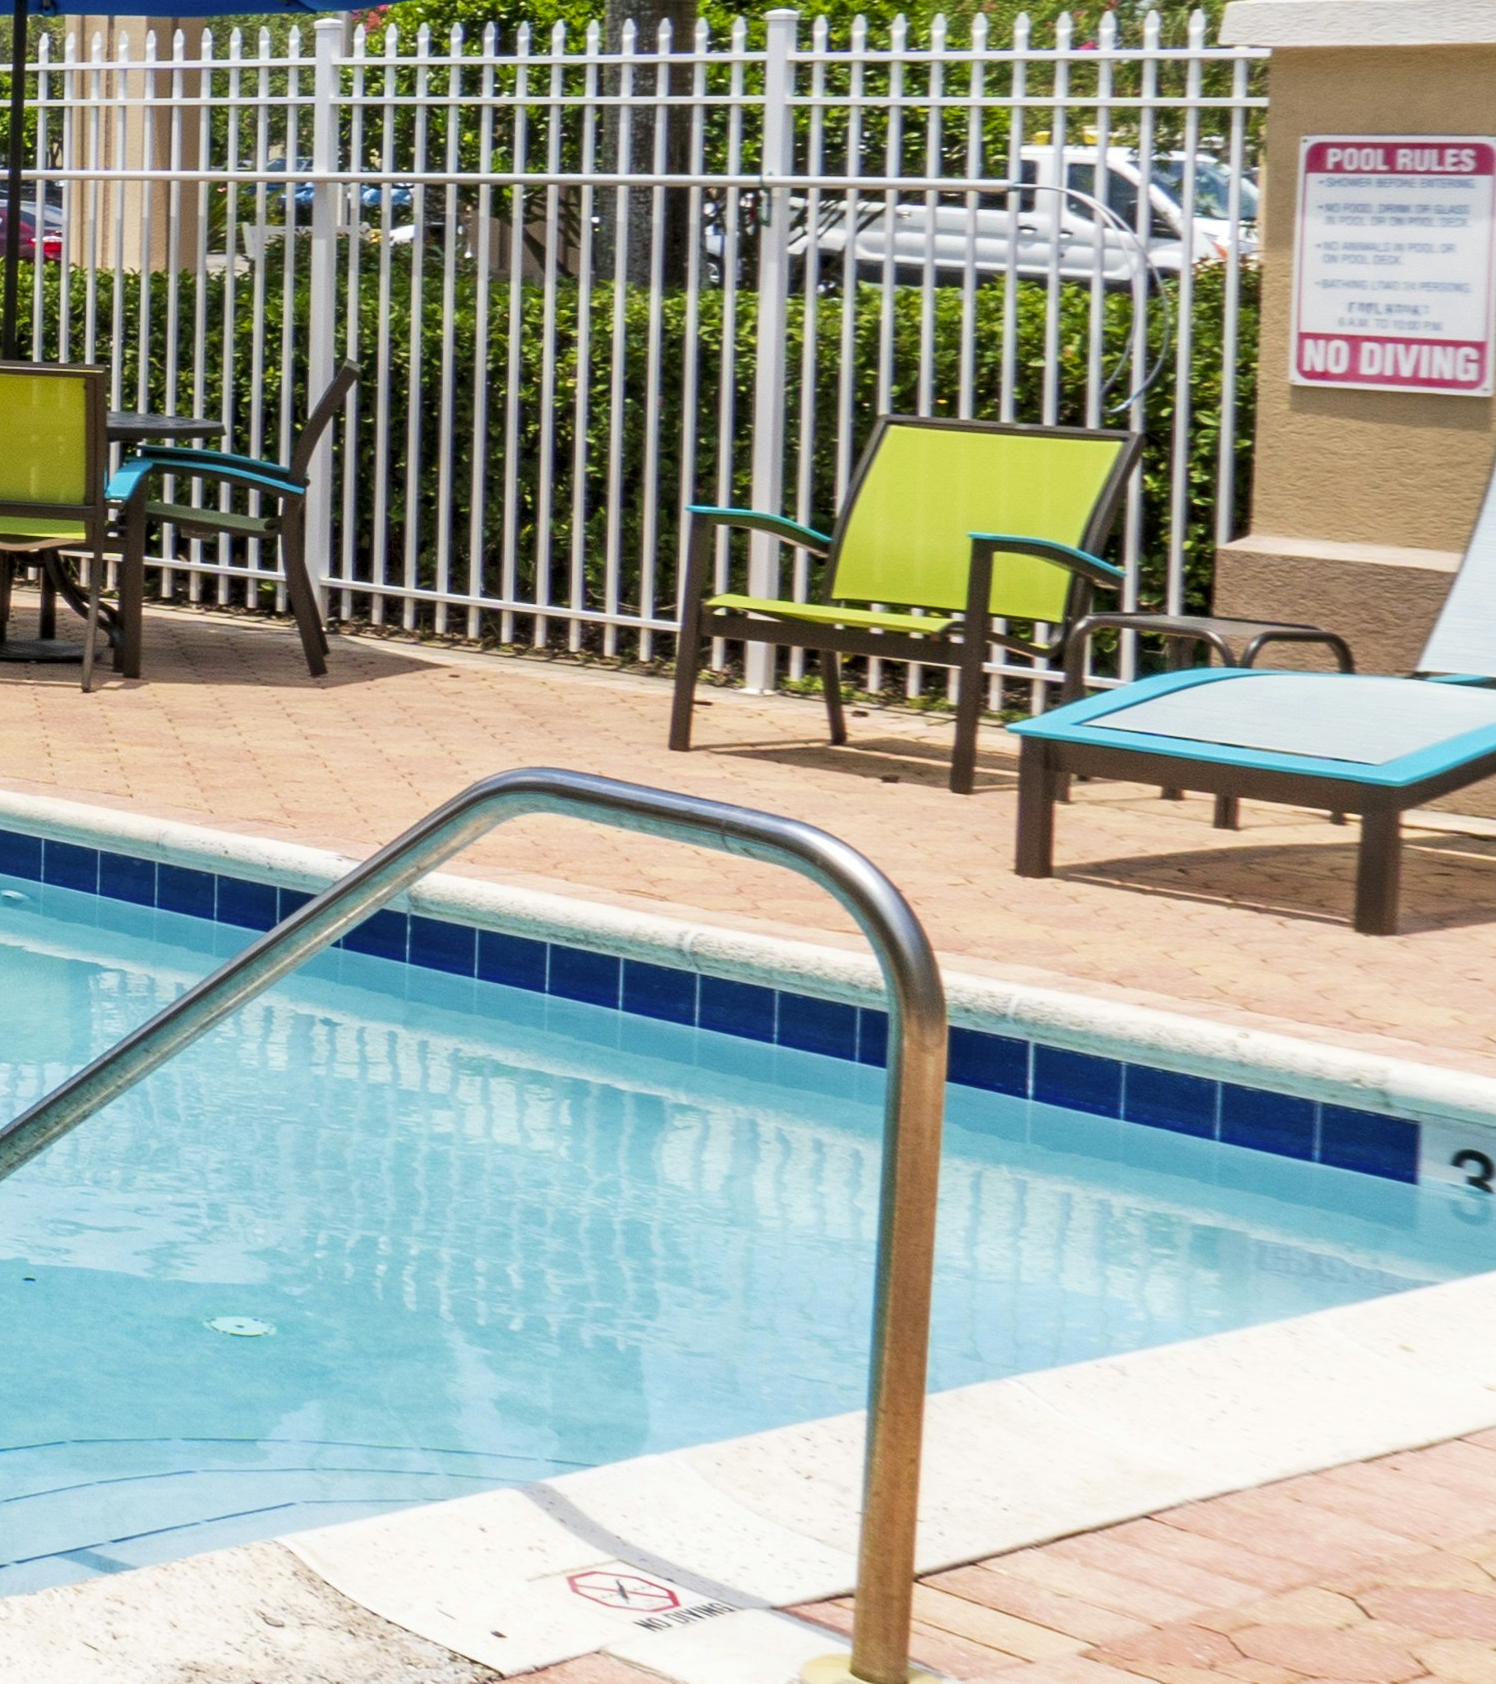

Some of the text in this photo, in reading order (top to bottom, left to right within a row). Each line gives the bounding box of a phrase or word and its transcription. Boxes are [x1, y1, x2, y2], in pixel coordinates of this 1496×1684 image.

[1326, 148, 1477, 172] POOL RULES
[1302, 338, 1479, 382] NO DIVING
[633, 1602, 737, 1633] NO DIVING
